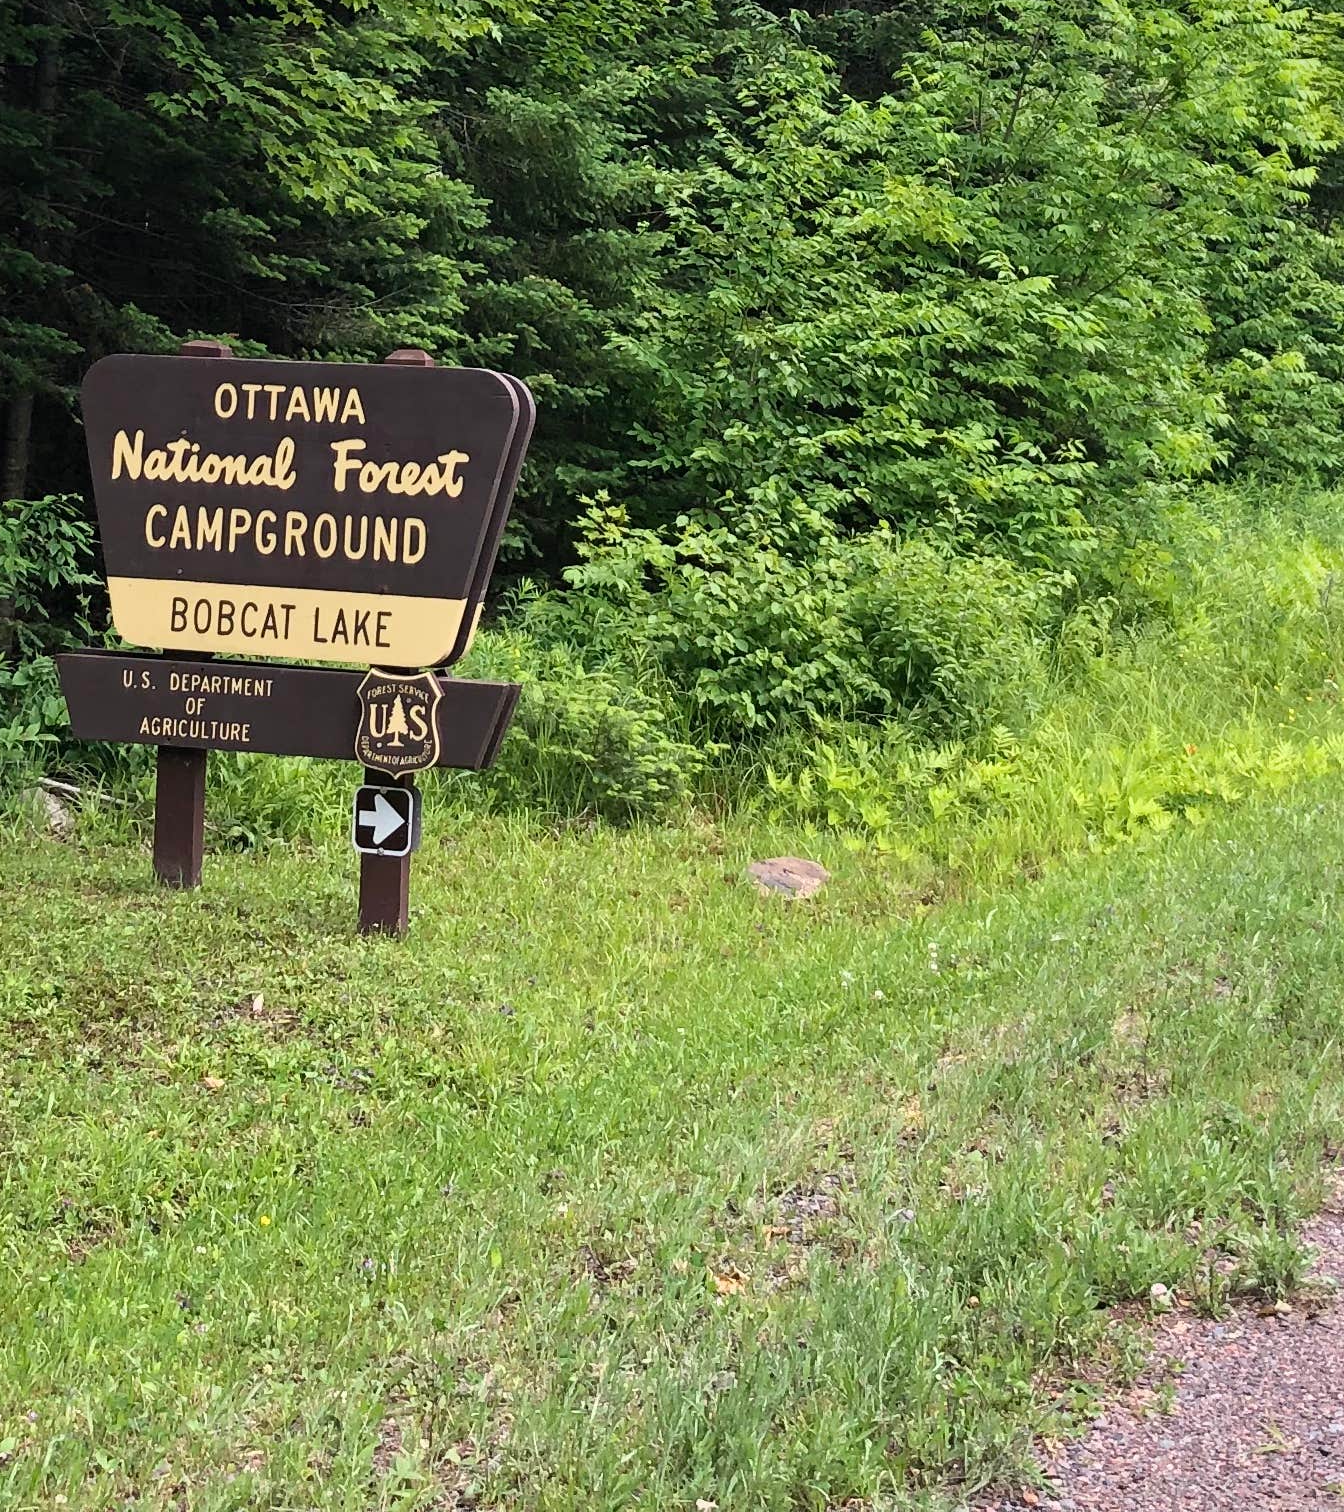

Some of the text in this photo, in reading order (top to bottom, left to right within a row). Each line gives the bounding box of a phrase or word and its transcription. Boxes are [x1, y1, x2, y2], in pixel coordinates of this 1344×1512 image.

[214, 382, 366, 425] OTTAWA
[111, 429, 470, 498] National Forest
[145, 503, 427, 565] CAMPGROUND
[170, 596, 393, 648] BOBCAT LAKE
[123, 669, 273, 697] U.S. DEPARTMENT
[367, 683, 430, 704] FOREST SERVICE
[185, 697, 206, 716] OF
[139, 716, 251, 742] AGRICULTURE
